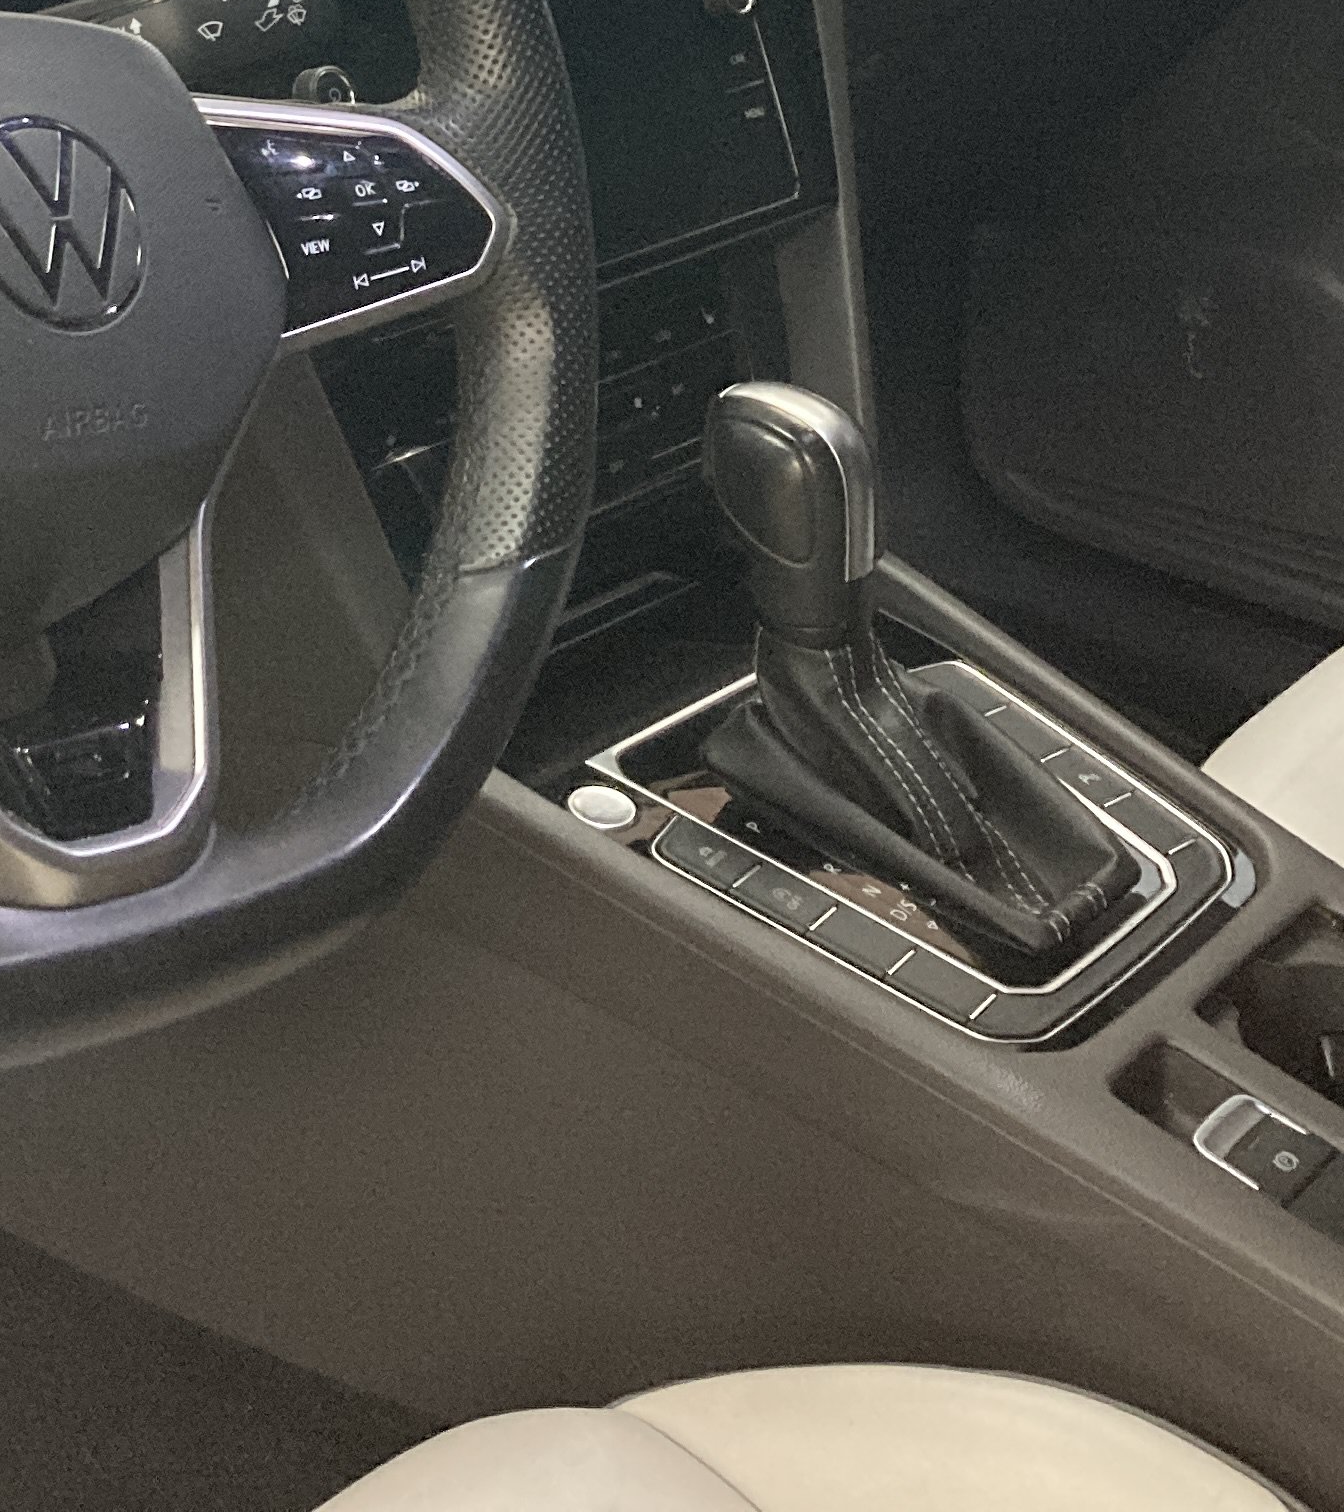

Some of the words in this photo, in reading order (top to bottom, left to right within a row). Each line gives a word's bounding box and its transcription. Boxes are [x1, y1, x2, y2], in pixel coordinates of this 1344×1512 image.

[355, 182, 376, 198] OK
[300, 239, 331, 256] VIEW
[861, 884, 882, 898] N
[890, 898, 918, 922] D/S
